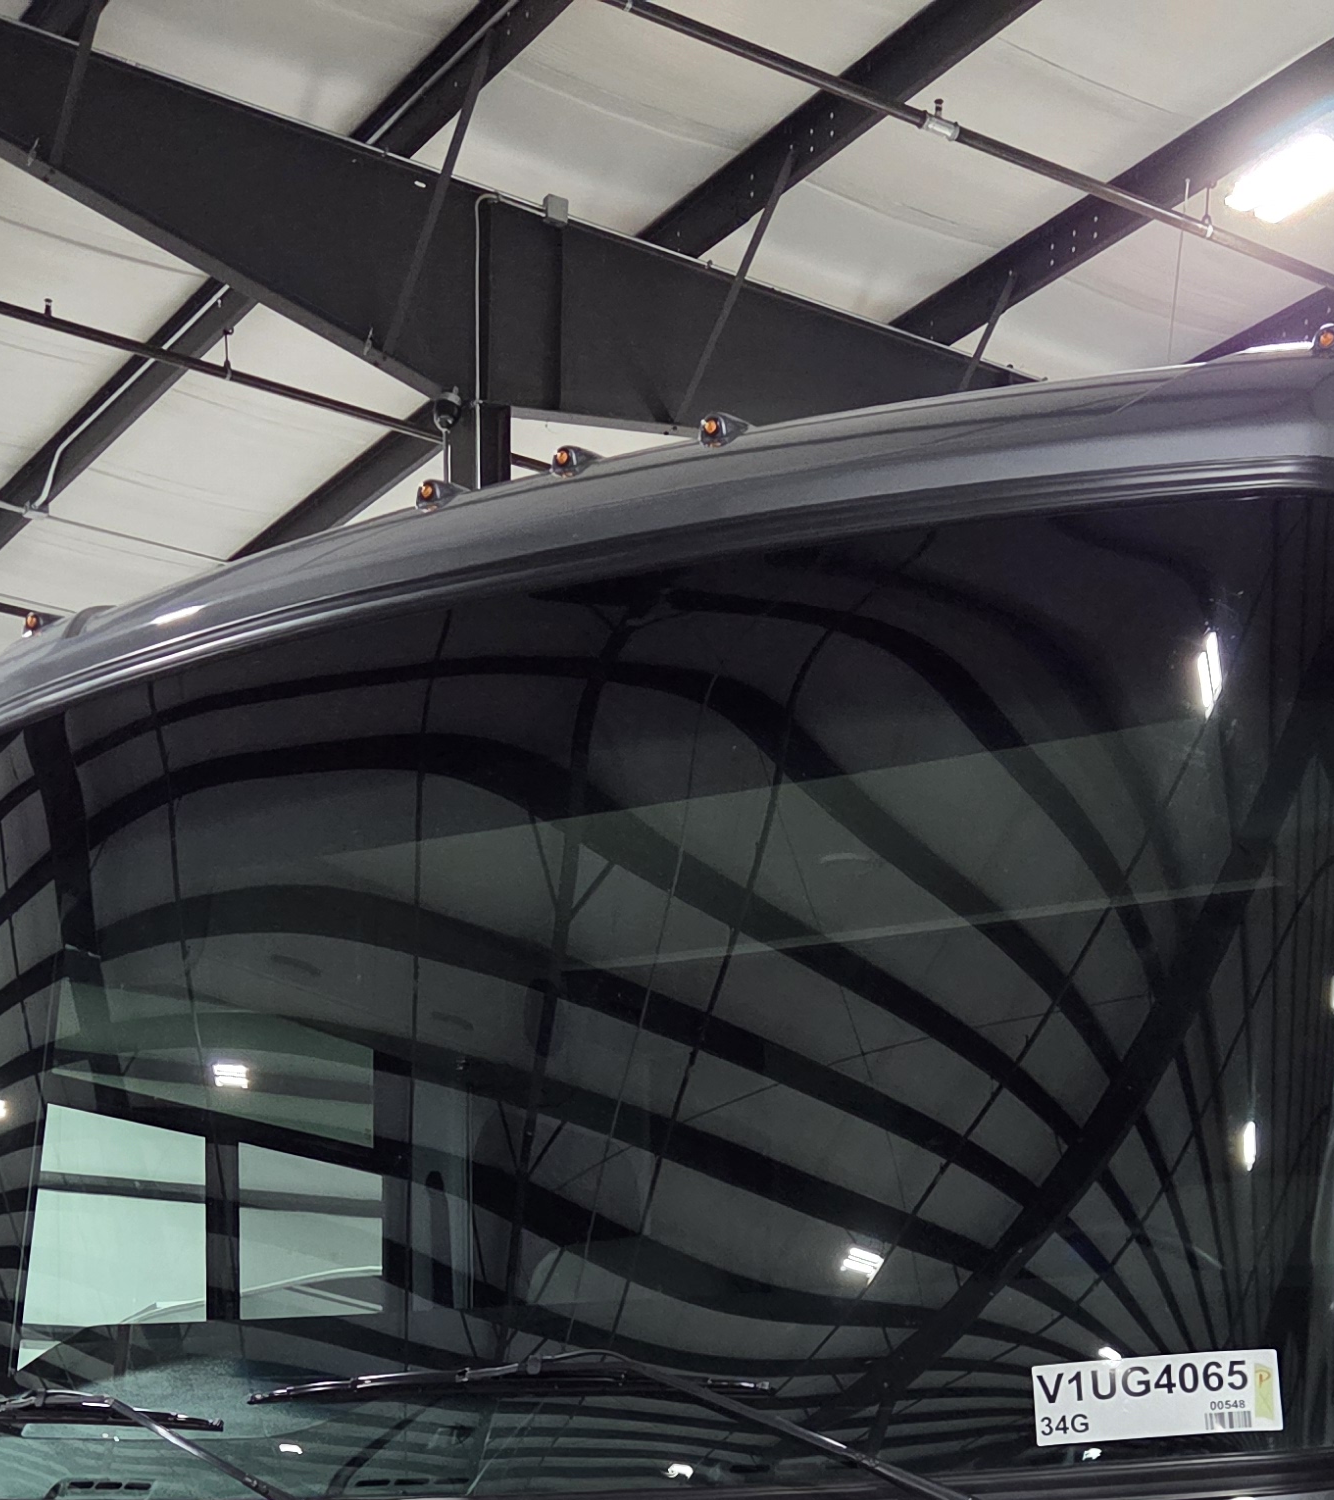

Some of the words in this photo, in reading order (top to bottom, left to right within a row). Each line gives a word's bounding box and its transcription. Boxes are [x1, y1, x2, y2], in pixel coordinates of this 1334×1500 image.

[1036, 1359, 1249, 1404] V1UG4065
[1210, 1400, 1245, 1411] 00548
[1040, 1413, 1090, 1437] 34G
